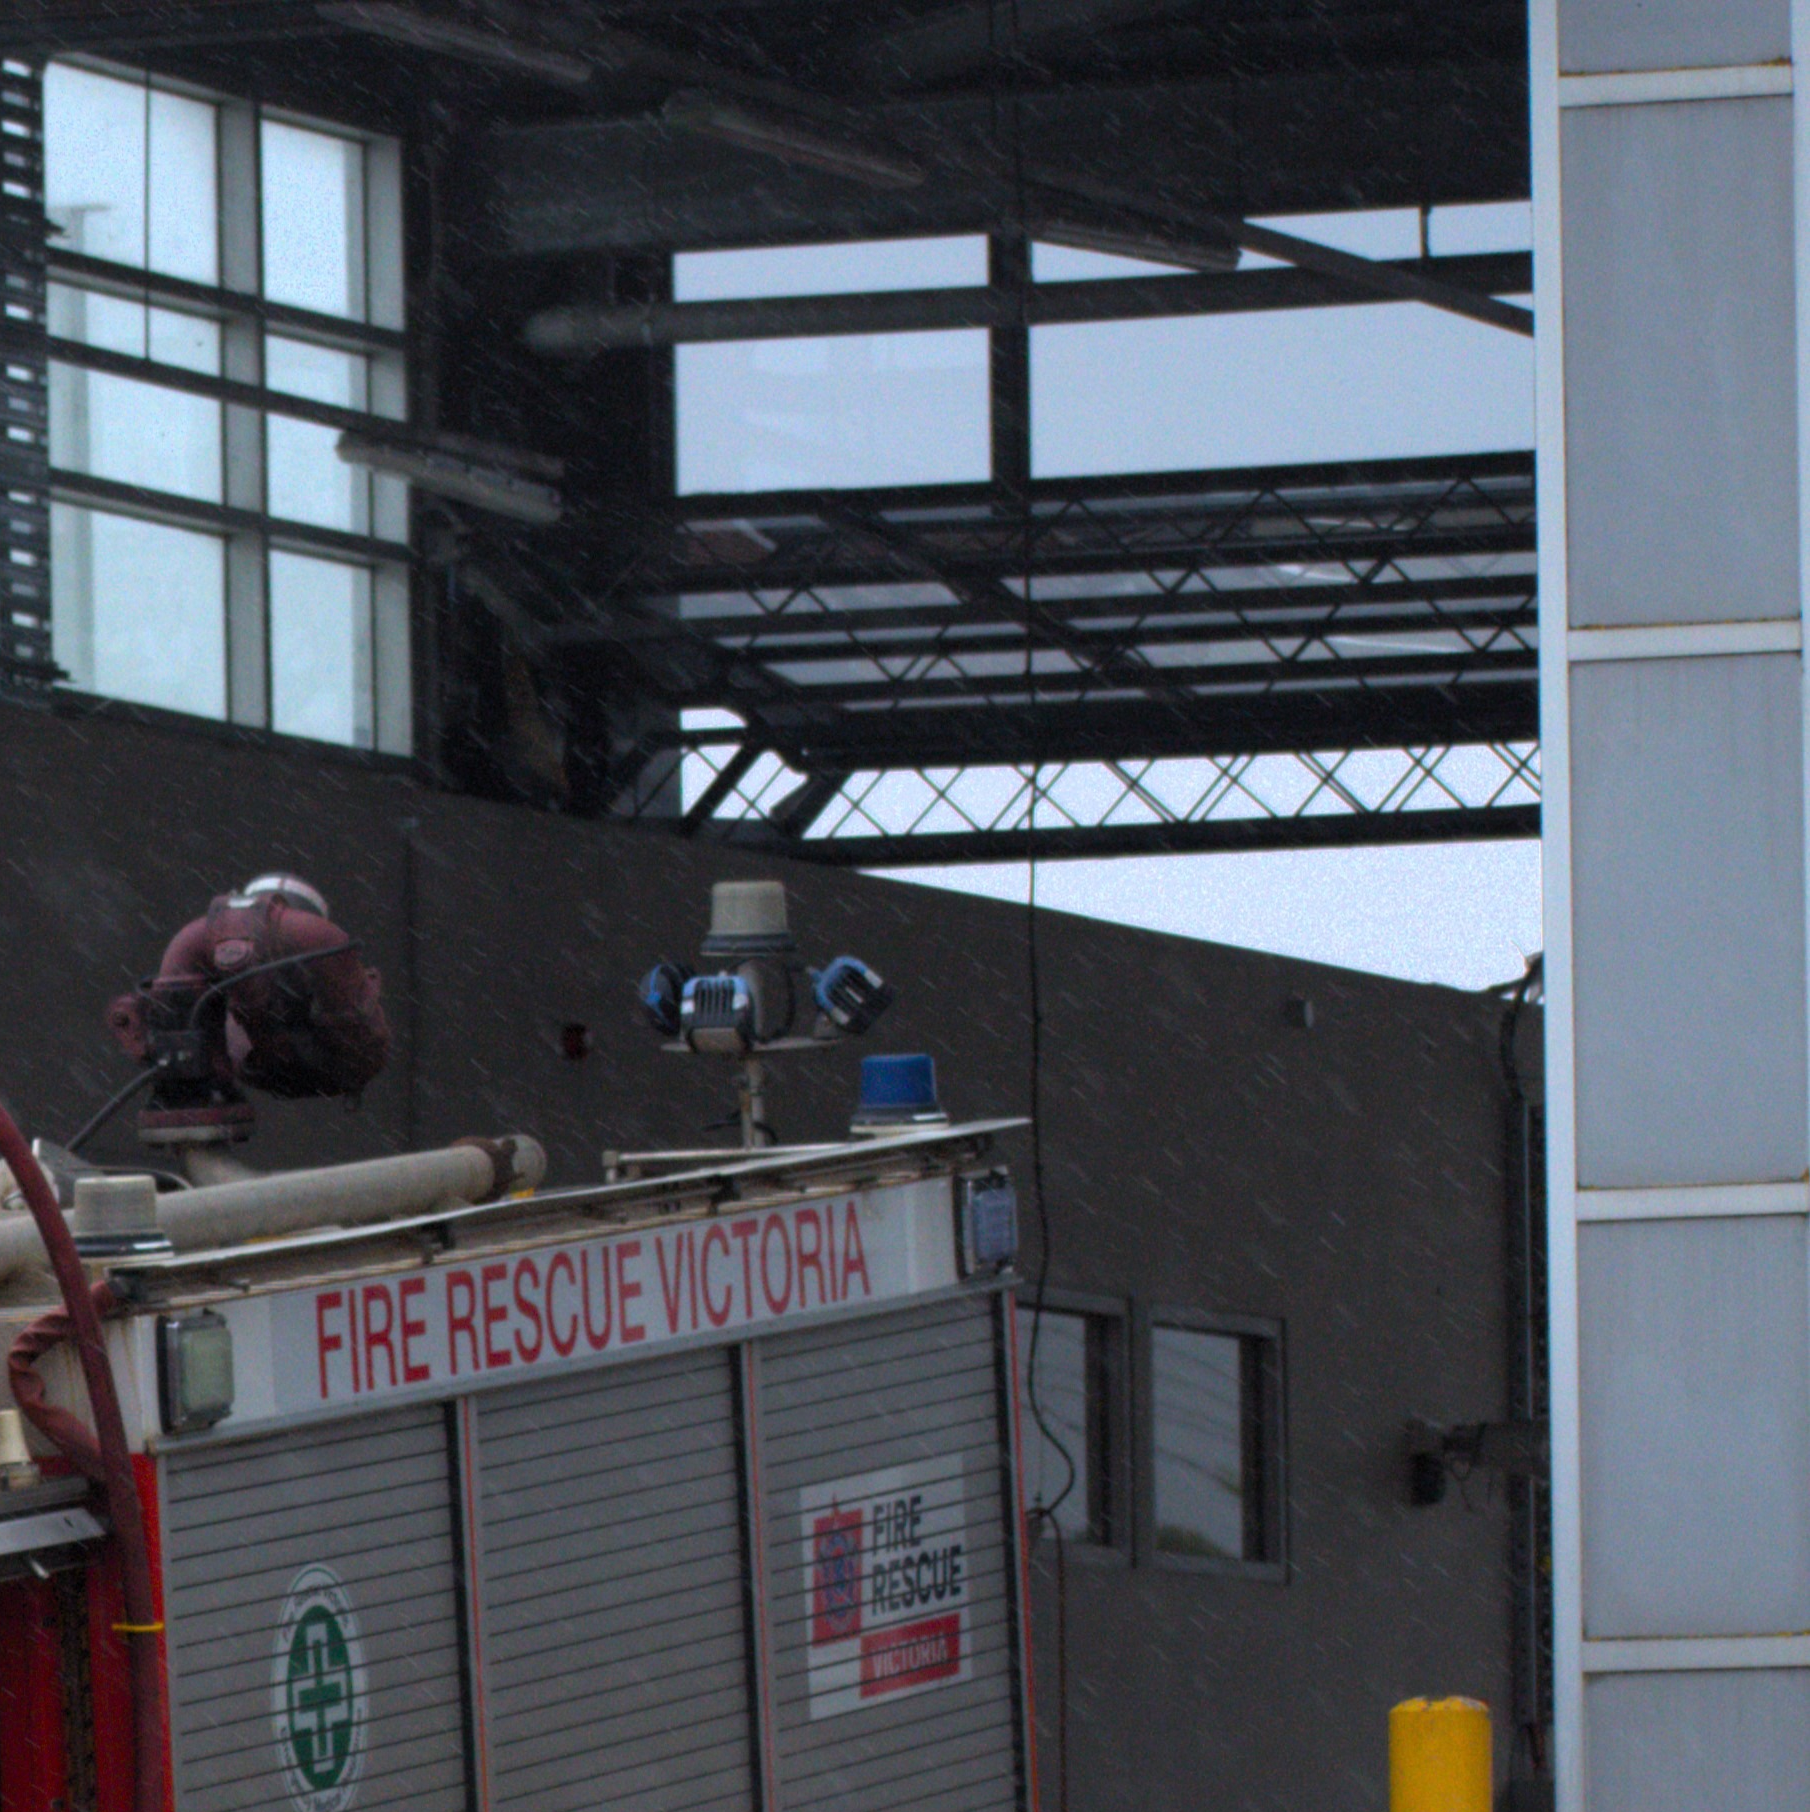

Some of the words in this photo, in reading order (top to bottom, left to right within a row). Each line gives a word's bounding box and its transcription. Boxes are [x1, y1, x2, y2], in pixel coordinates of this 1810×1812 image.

[315, 1276, 431, 1400] FIRE
[446, 1240, 646, 1376] RESCUE
[655, 1200, 870, 1334] VICTORIA
[873, 1496, 922, 1556] FIRE
[872, 1545, 961, 1616] RESCUE
[873, 1632, 948, 1678] VICTORIA
